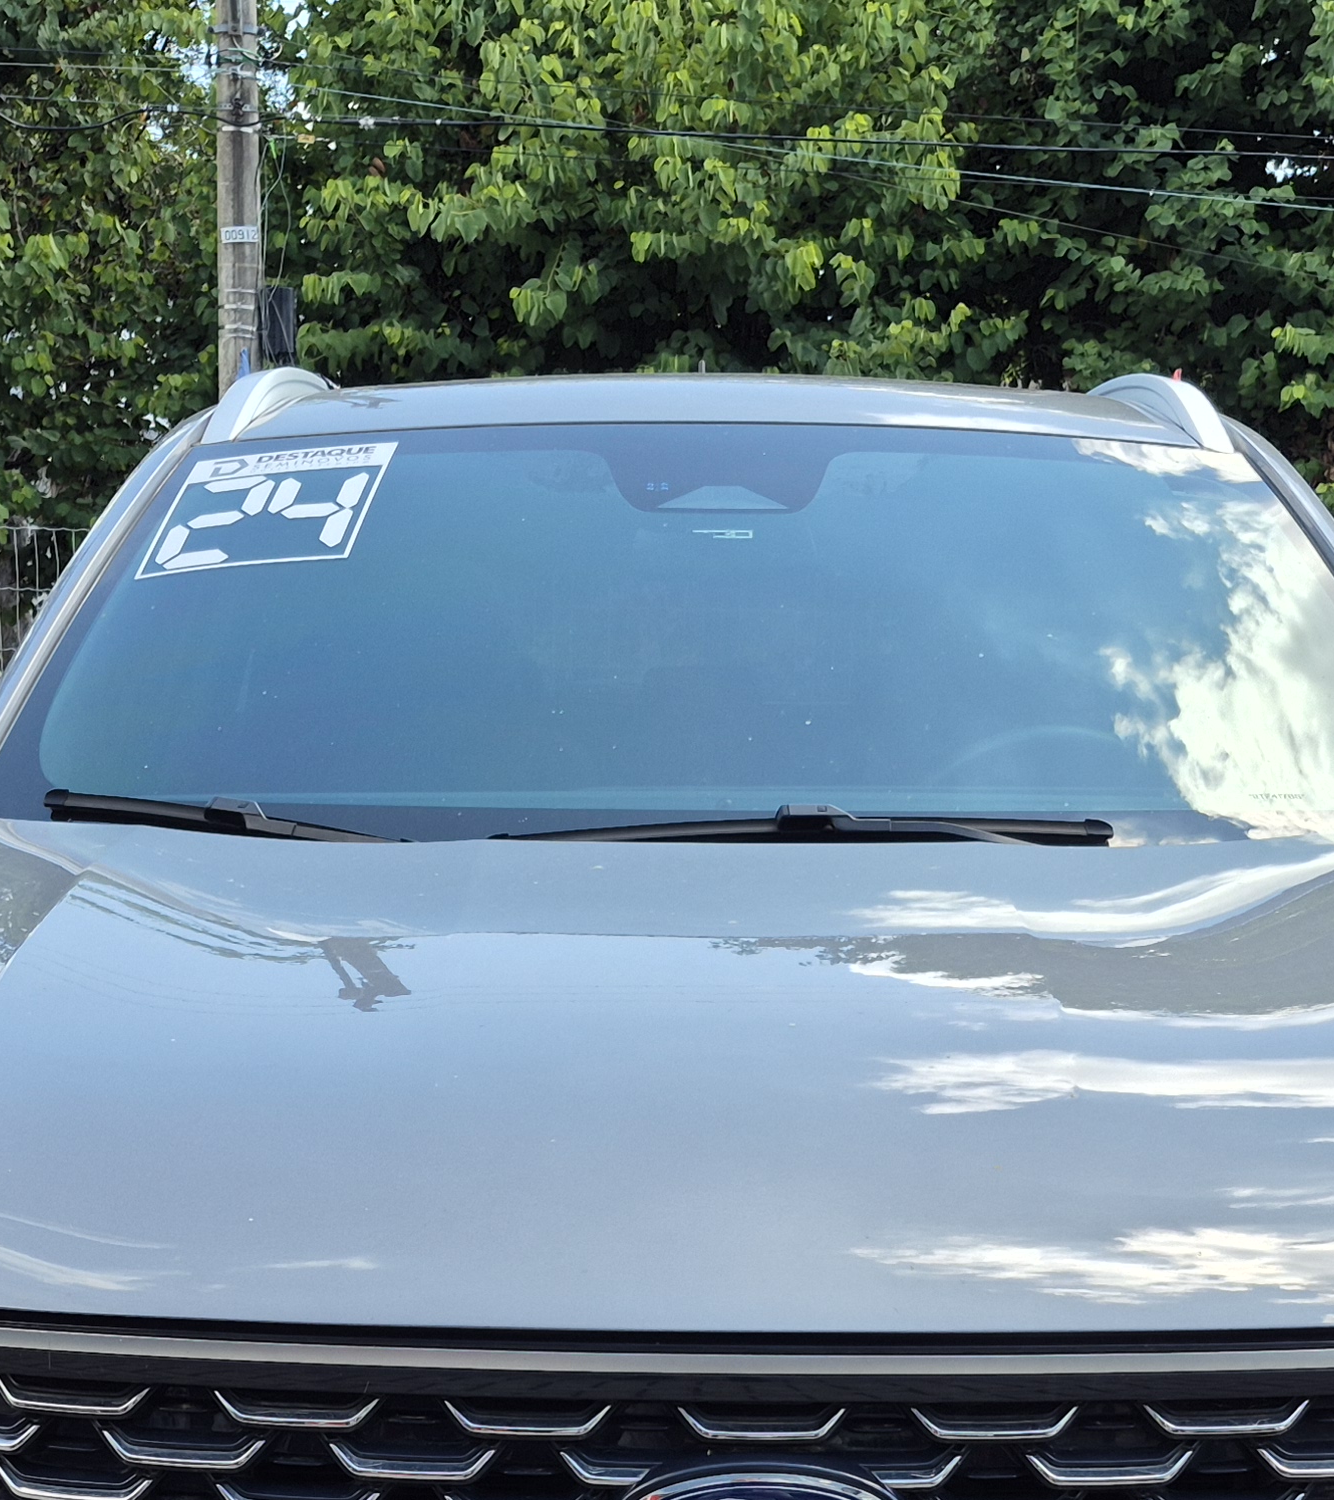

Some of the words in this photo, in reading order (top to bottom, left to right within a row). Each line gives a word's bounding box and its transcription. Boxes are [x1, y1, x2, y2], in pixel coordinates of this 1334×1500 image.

[253, 455, 372, 469] SEMINOVOS
[256, 446, 376, 463] DESTAQUE
[155, 472, 370, 570] 24
